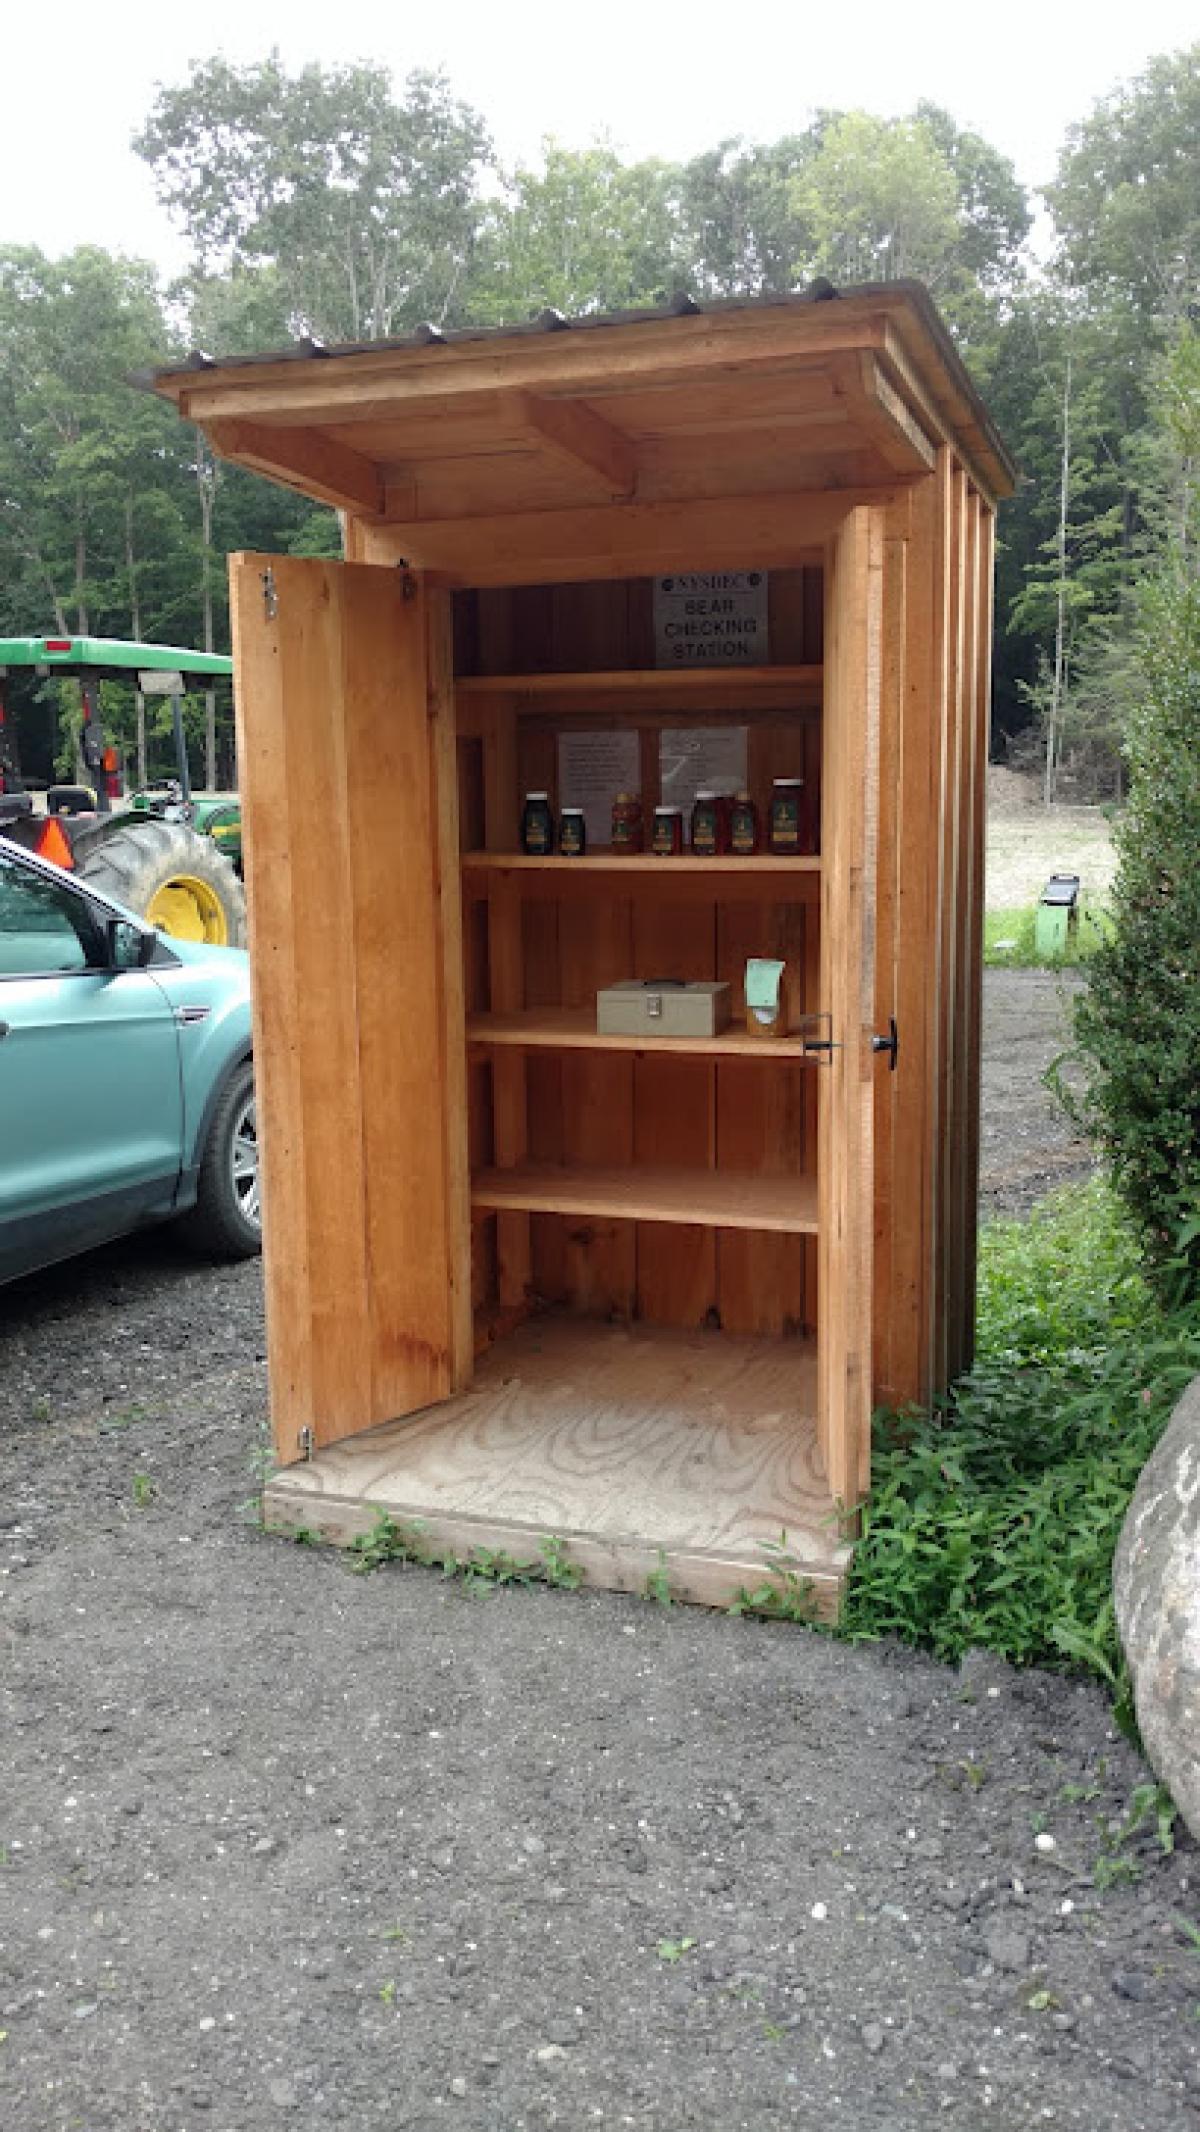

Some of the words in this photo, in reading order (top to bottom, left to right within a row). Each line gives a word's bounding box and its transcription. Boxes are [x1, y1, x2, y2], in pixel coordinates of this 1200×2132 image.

[685, 598, 735, 615] BEAR
[664, 619, 758, 638] CHECKING
[672, 640, 750, 659] STATION
